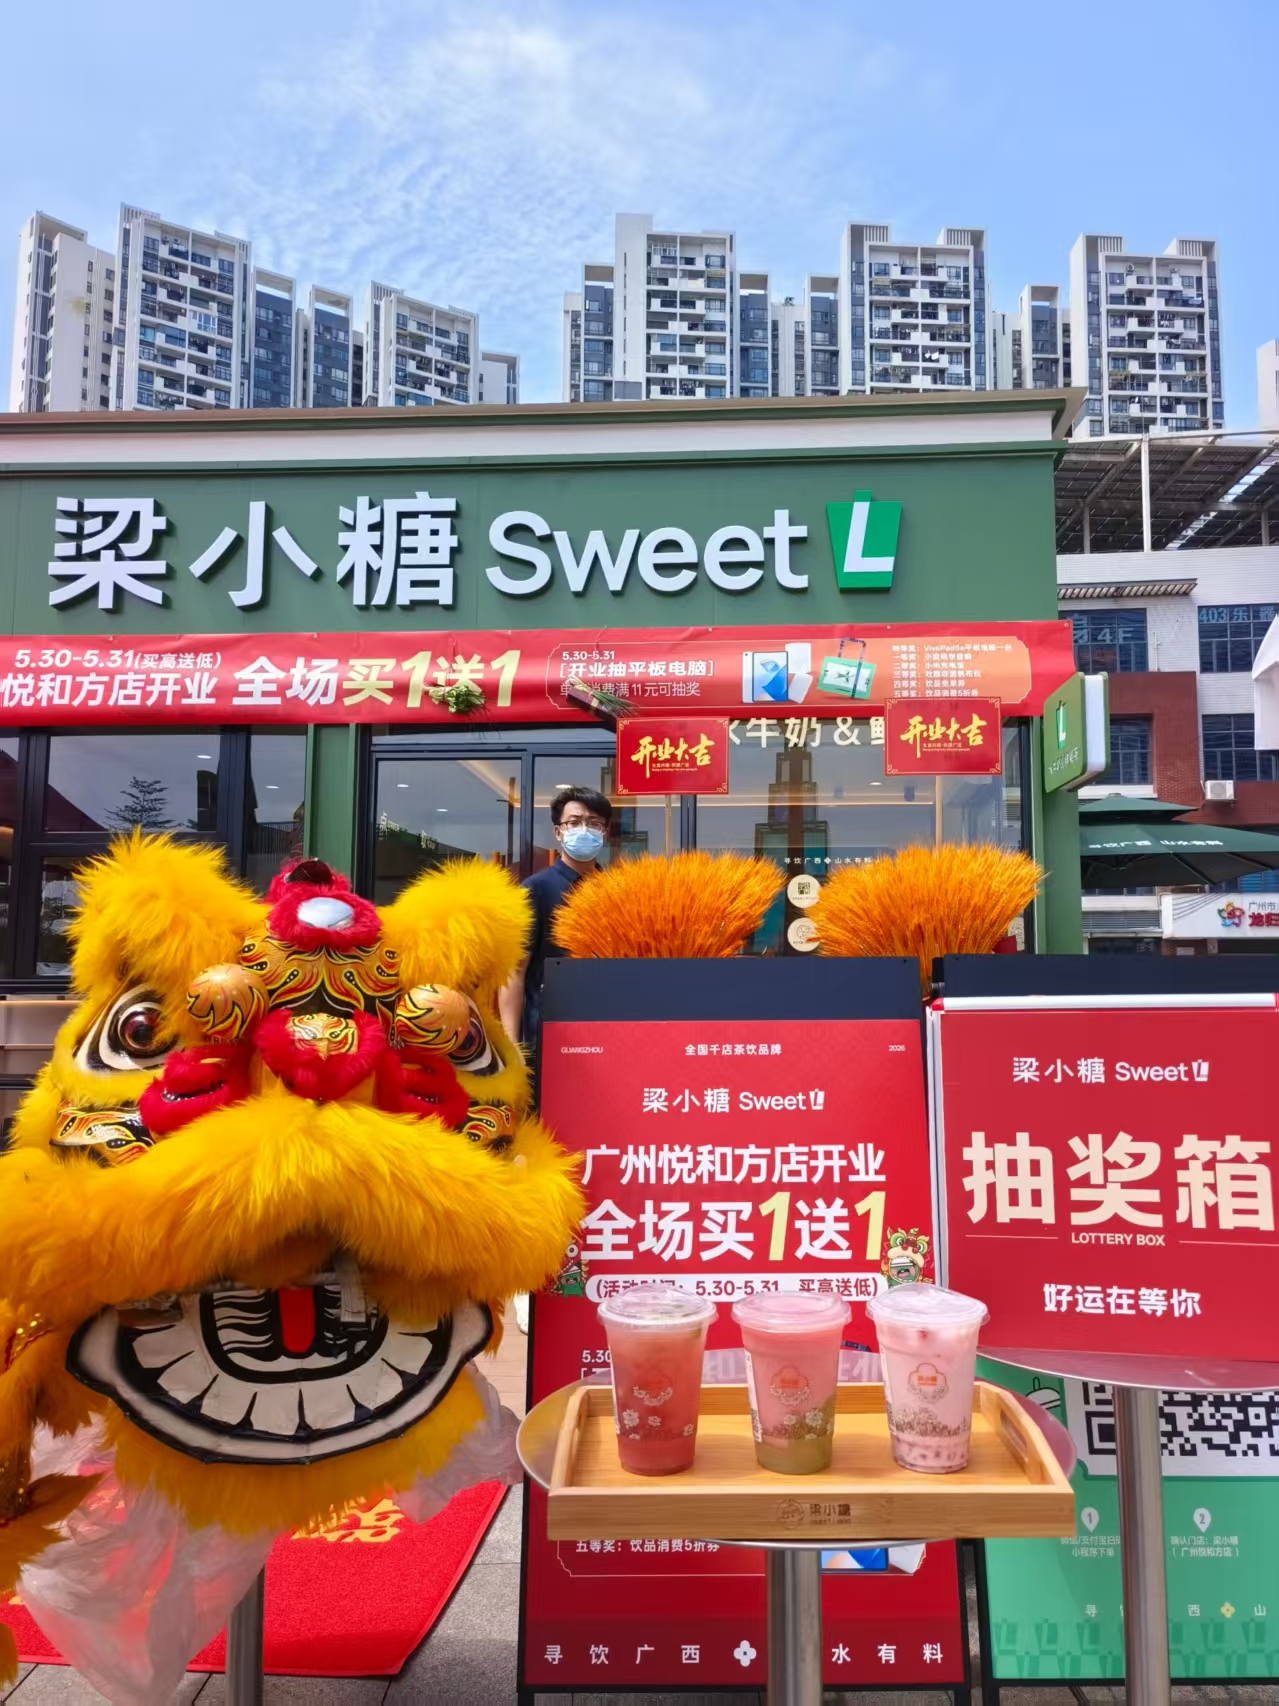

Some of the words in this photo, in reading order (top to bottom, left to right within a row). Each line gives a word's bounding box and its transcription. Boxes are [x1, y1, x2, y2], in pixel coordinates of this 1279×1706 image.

[48, 491, 458, 609] 梁小糖
[485, 510, 809, 595] Sweet
[559, 660, 714, 678] [开业抽平板电脑]
[562, 651, 615, 661] 5.30-5.31
[0, 671, 219, 707] 悦和方店开业
[232, 650, 521, 708] 全场买1送1
[900, 713, 987, 759] 开业大吉
[631, 733, 715, 779] 开业大吉
[560, 1046, 603, 1054] GUANGZHOU
[684, 1043, 782, 1056] 全国千店茶饮品牌
[888, 1044, 906, 1052] 2026
[1012, 1057, 1105, 1084] 梁小糖
[1115, 1061, 1189, 1082] Sweet
[642, 1087, 730, 1113] 梁小糖
[739, 1091, 806, 1111] Sweet
[581, 1143, 887, 1184] 广州悦和方店开业
[962, 1131, 1276, 1231] 抽奖箱
[581, 1191, 887, 1261] 全场买1送1
[1071, 1232, 1133, 1245] LOTTERY
[1136, 1234, 1166, 1247] BOX
[1043, 1283, 1202, 1318] 好运在等你
[544, 1644, 701, 1665] 寻饮广西
